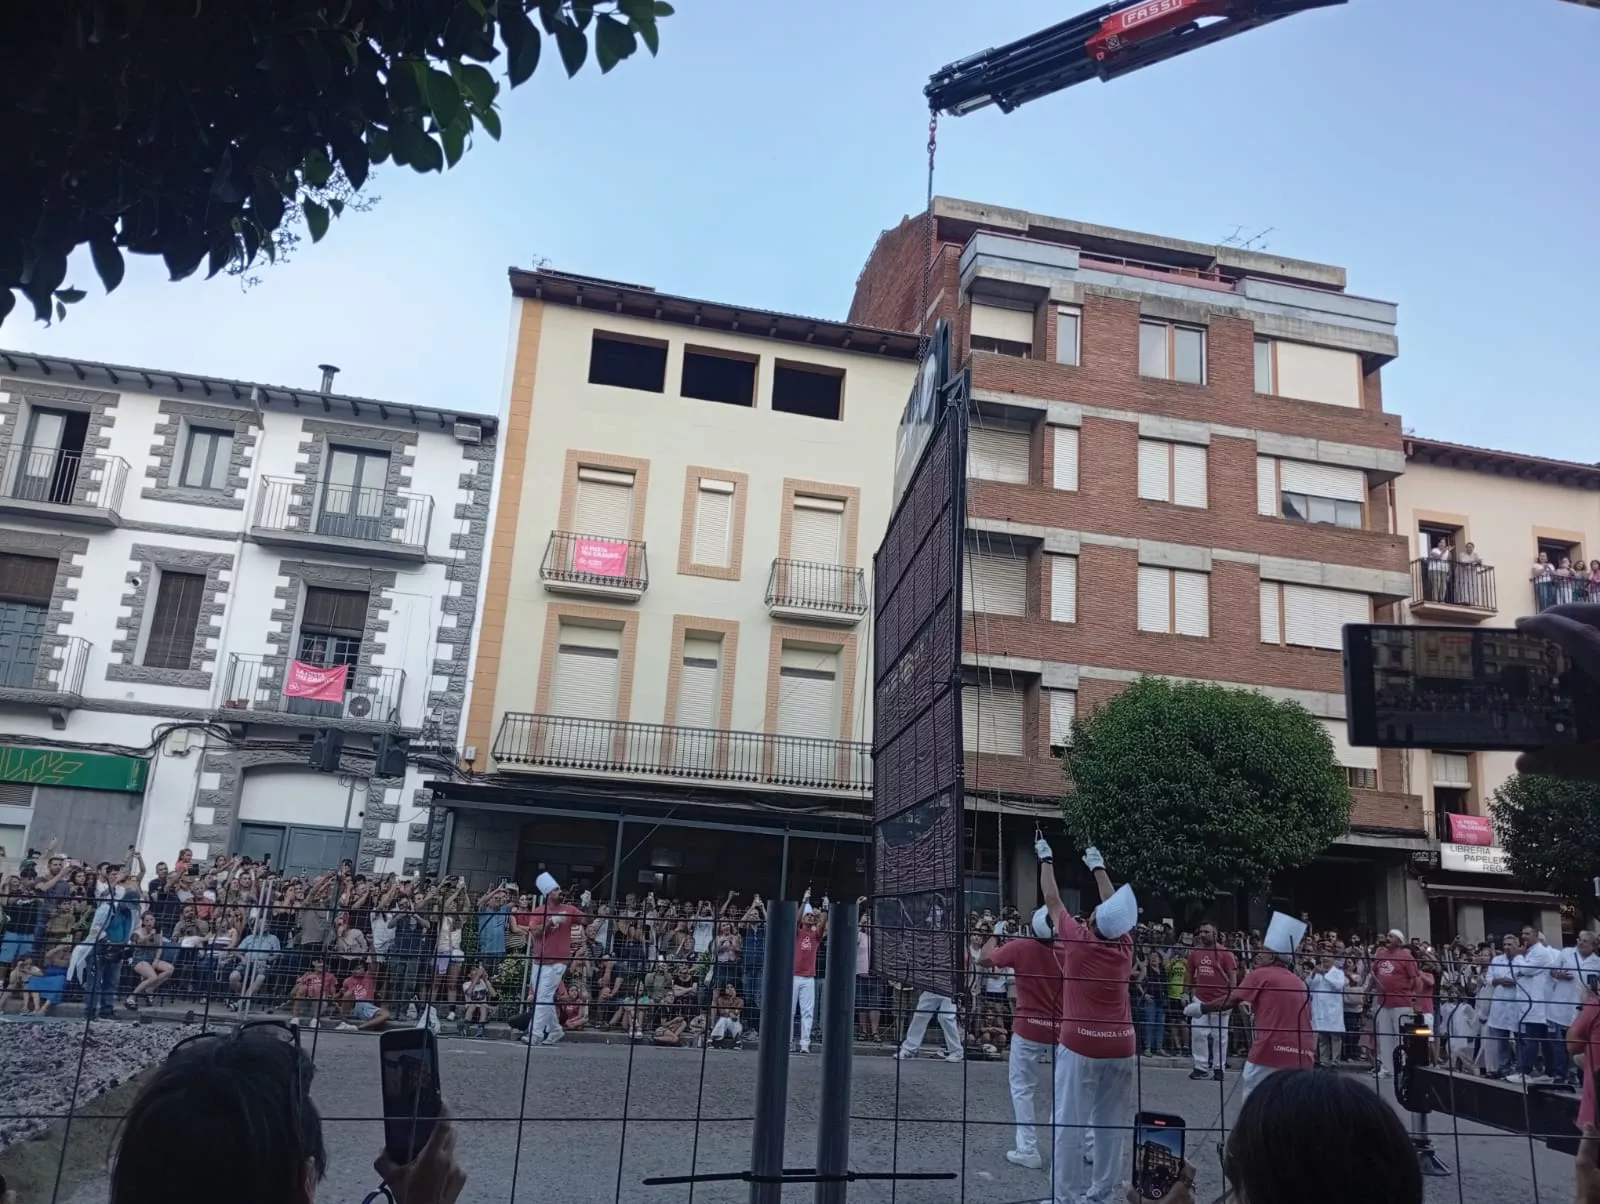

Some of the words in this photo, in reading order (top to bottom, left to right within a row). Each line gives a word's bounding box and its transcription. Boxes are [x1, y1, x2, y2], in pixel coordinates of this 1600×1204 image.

[1127, 0, 1177, 23] FASSI
[1450, 845, 1490, 854] LIBRERIA
[1483, 864, 1512, 873] REGA
[1077, 1027, 1117, 1038] LONGANIZA
